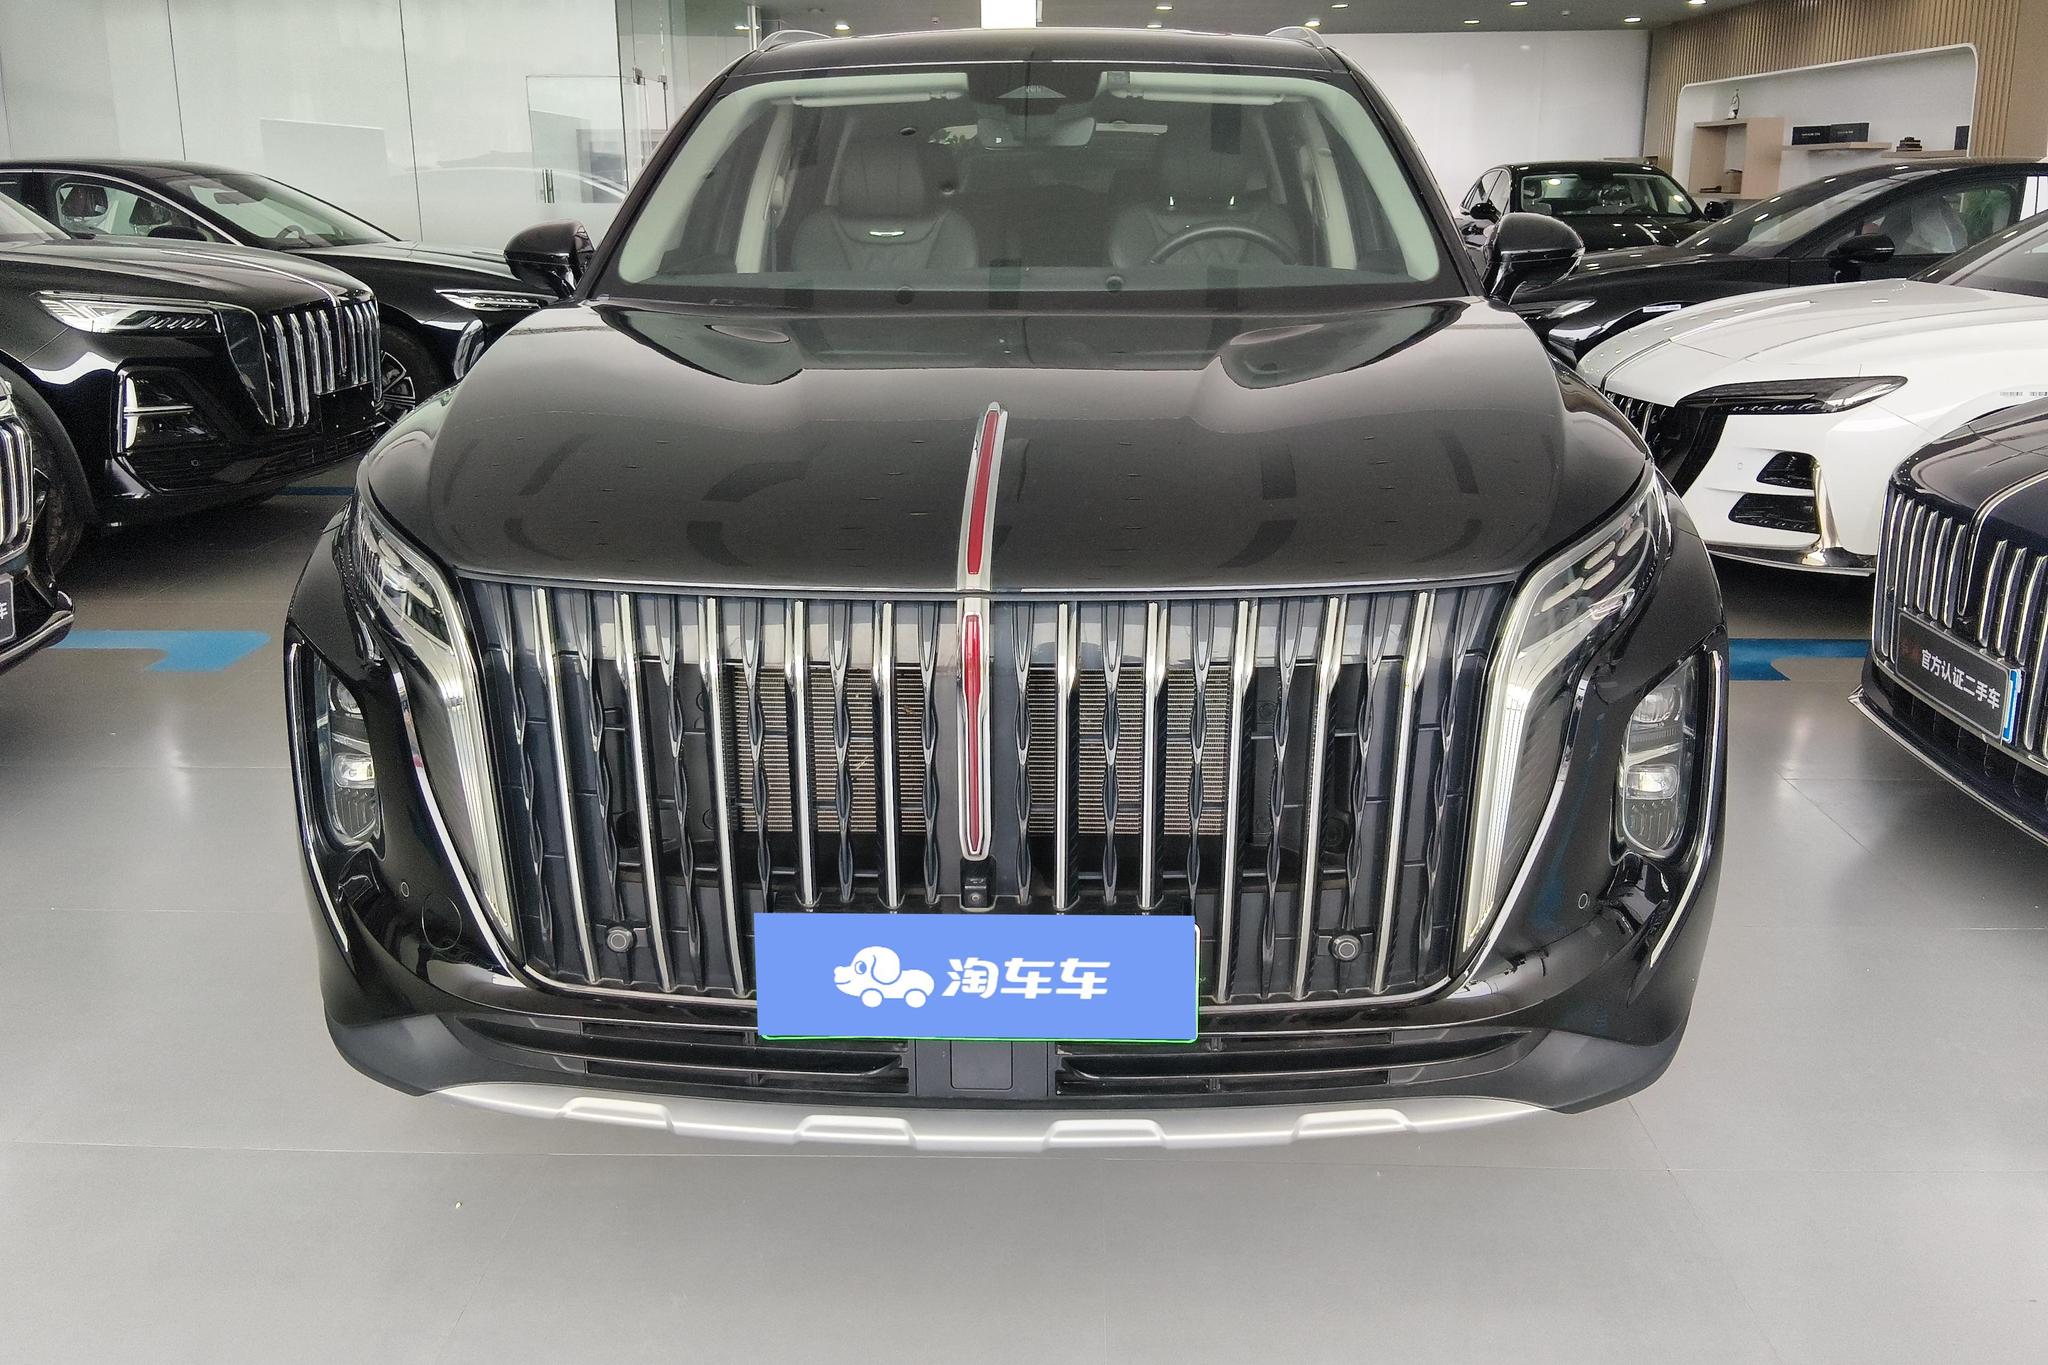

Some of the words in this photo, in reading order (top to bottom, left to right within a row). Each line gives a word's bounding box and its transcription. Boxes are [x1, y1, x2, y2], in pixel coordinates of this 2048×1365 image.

[1921, 648, 2000, 709] 官方认证二手车
